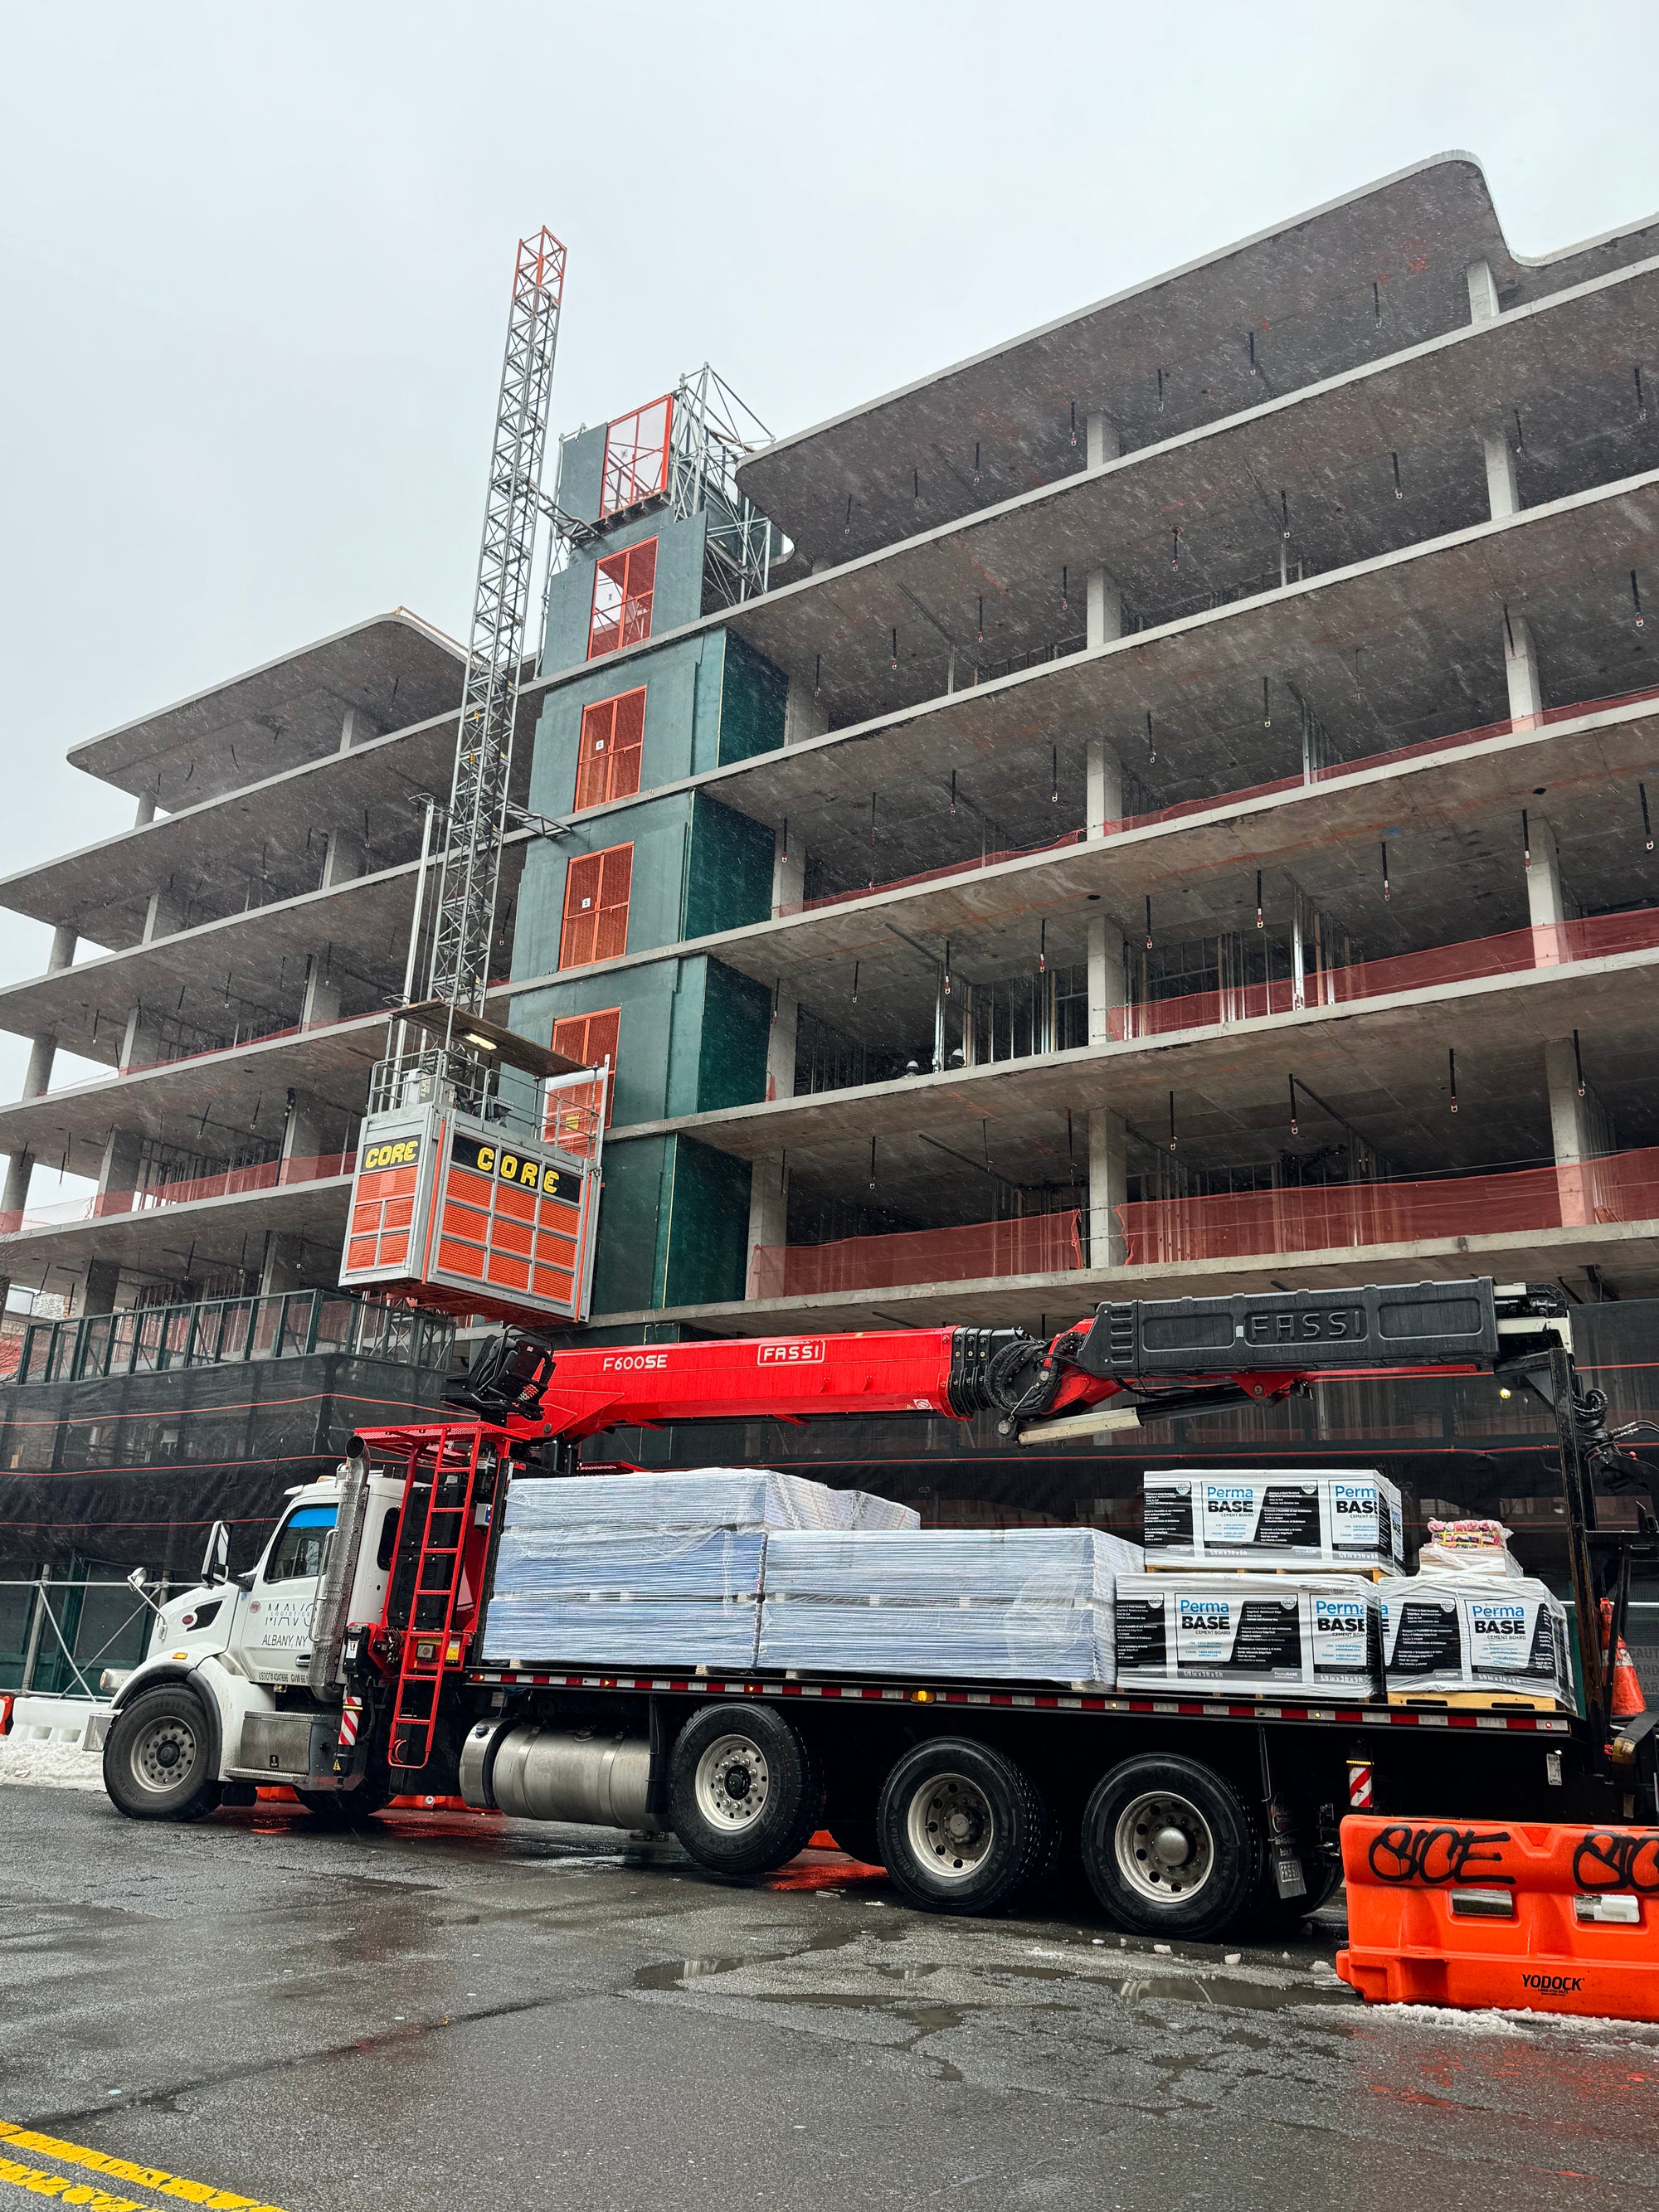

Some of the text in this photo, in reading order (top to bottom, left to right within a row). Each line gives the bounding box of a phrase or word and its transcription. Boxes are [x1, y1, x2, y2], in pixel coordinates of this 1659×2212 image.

[365, 1140, 418, 1169] CORE
[477, 1146, 560, 1194] CORE
[1251, 1310, 1361, 1341] FASSI
[762, 1345, 820, 1364] FASSI
[602, 1354, 668, 1371] F600SE
[1208, 1486, 1253, 1498] Perma
[1208, 1500, 1253, 1513] BASE
[1180, 1599, 1229, 1613] Perma
[1472, 1605, 1524, 1617] Perma
[1182, 1616, 1230, 1630] BASE
[1474, 1620, 1525, 1634] BASE
[262, 1634, 309, 1648] ALBANY, NY
[291, 1674, 300, 1684] GVW
[1521, 1973, 1583, 1991] YODOCK
